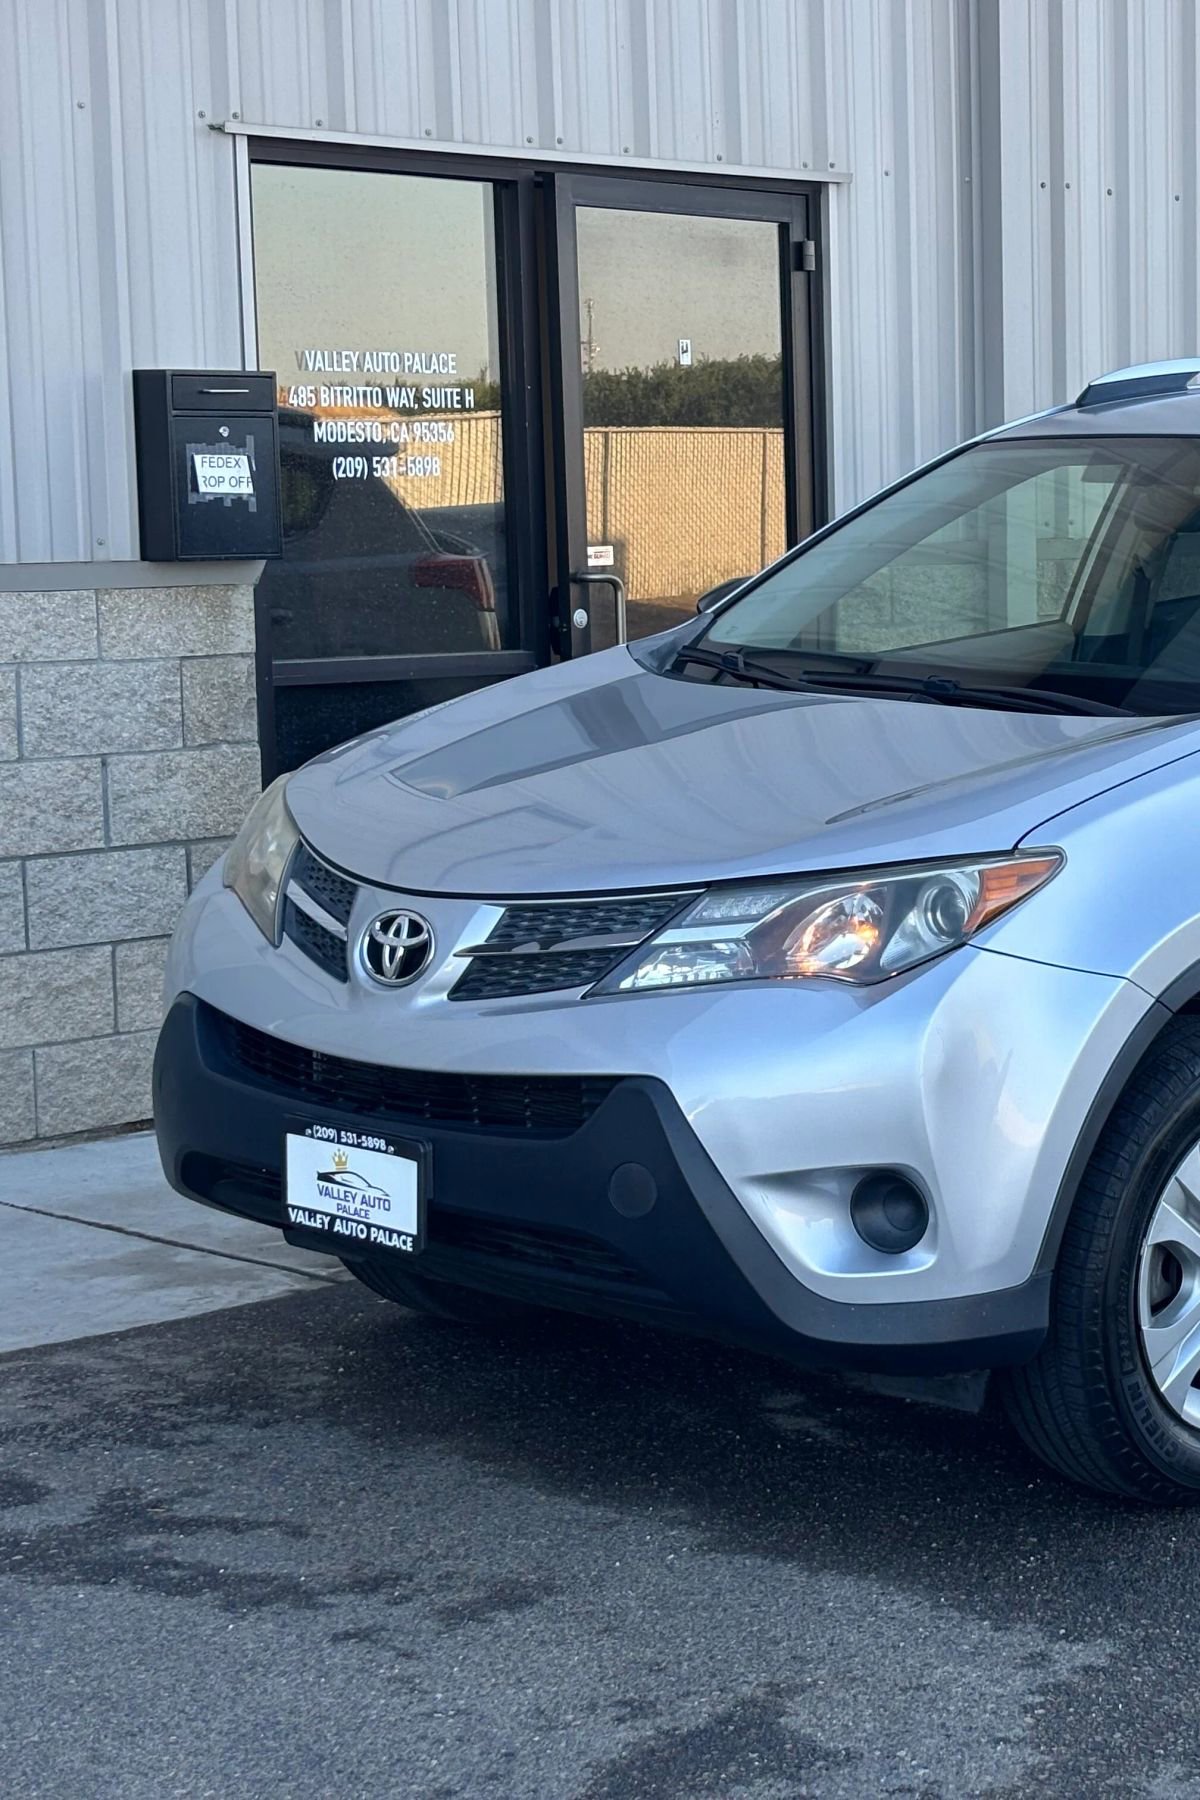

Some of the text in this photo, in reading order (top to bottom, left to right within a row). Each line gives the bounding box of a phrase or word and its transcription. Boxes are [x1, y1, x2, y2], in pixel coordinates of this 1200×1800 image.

[304, 350, 457, 374] VALLEY AUTO PALACE
[288, 385, 475, 410] 485 BITRITTO WAY, SUITE H
[313, 421, 455, 444] MODESTO, CA 95356
[200, 456, 242, 469] FEDEX
[332, 456, 441, 480] (209) 531-5898
[313, 1124, 387, 1151] (209) 531-5898
[317, 1183, 391, 1212] VALLEY AUTO
[336, 1202, 371, 1219] PALACE
[287, 1207, 414, 1251] VALLEY AUTO PALACE
